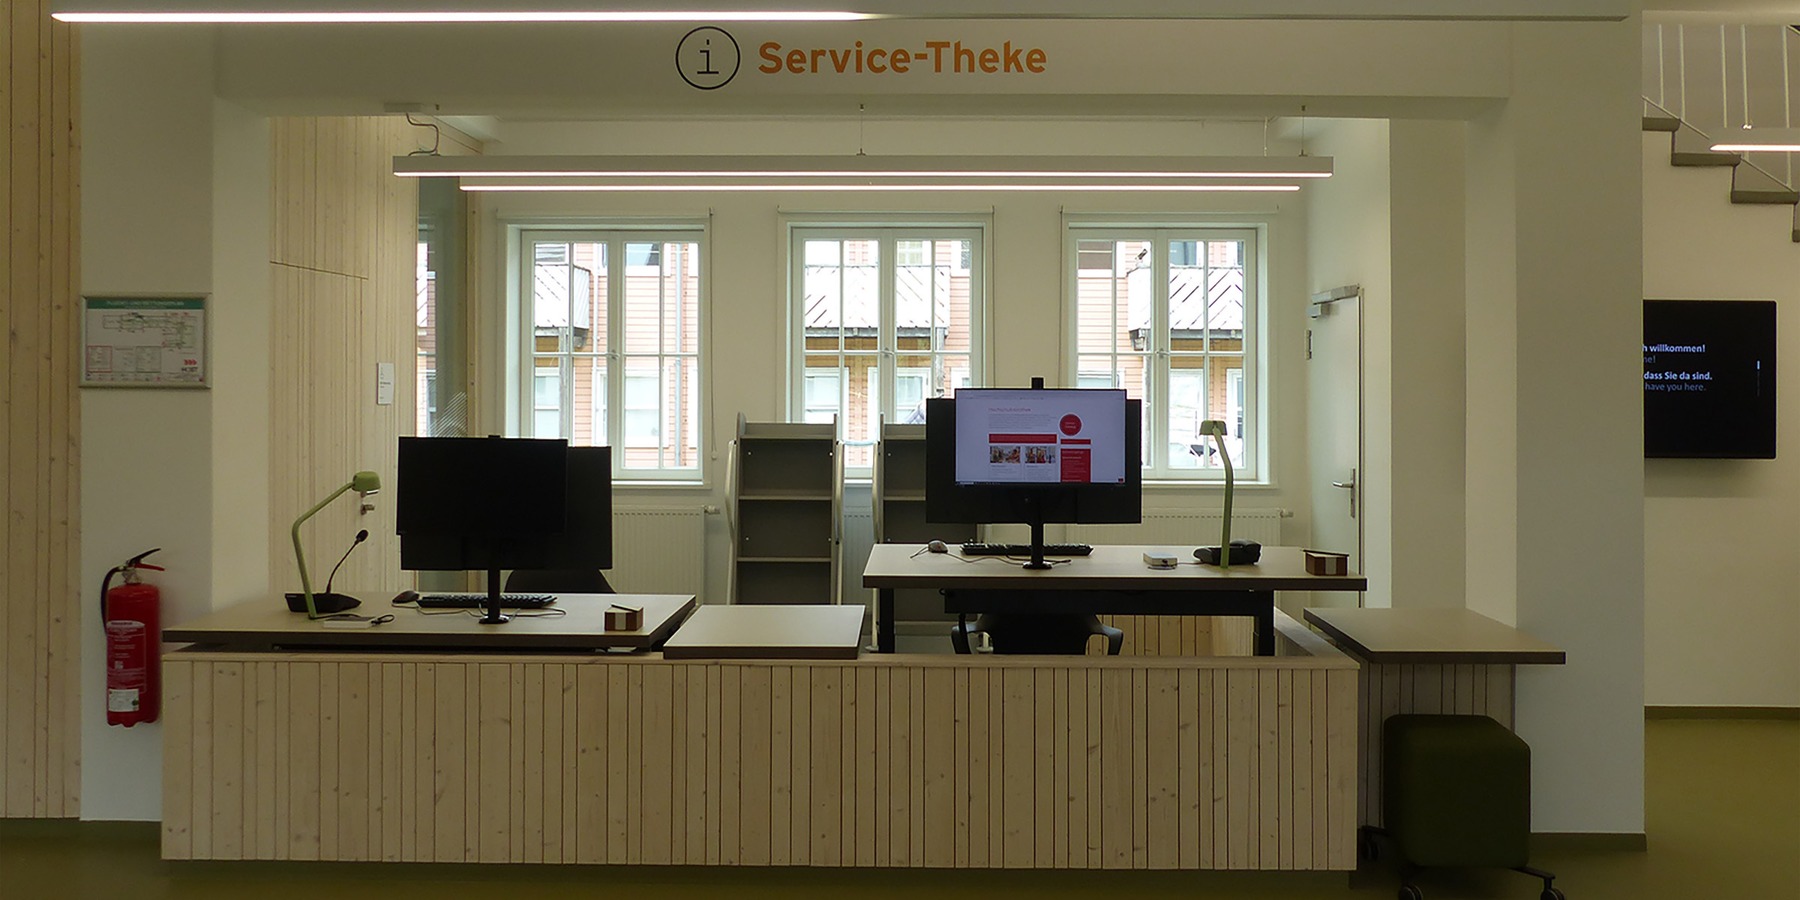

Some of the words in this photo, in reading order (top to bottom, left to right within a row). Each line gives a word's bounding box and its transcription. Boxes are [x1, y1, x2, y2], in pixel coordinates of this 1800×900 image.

[758, 40, 1047, 74] Service-Theke
[1649, 344, 1706, 352] willkommen!
[1644, 371, 1663, 380] dass
[1664, 371, 1678, 380] Sie
[1679, 371, 1691, 380] da
[1692, 371, 1713, 380] sind.
[1645, 382, 1665, 391] have
[1666, 384, 1683, 392] you
[1684, 382, 1707, 391] here.
